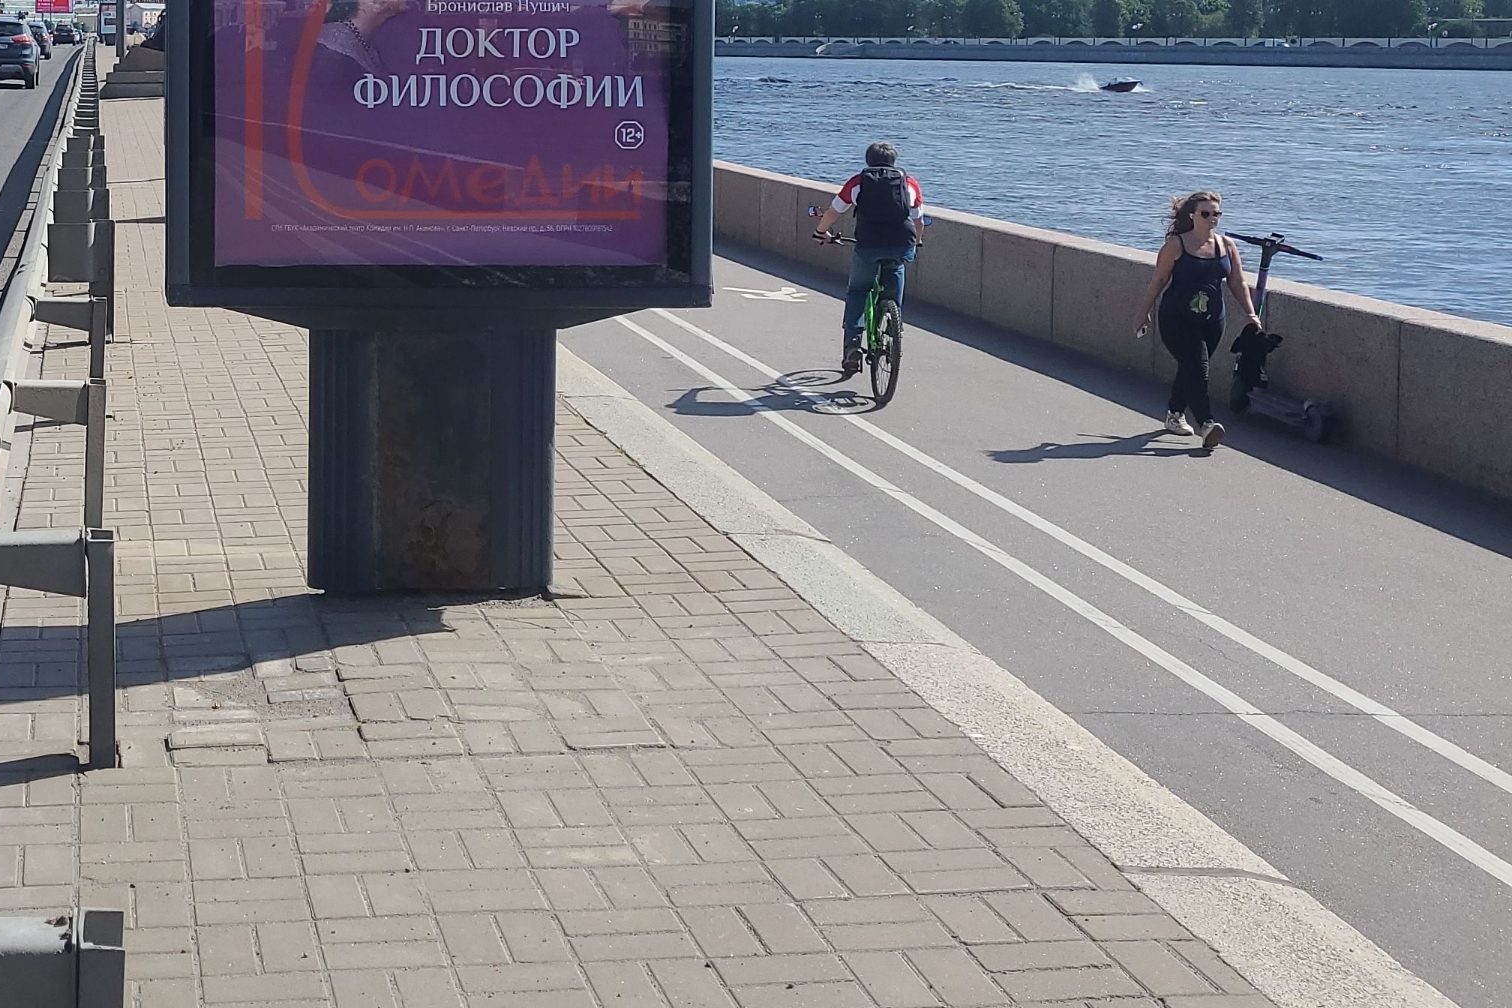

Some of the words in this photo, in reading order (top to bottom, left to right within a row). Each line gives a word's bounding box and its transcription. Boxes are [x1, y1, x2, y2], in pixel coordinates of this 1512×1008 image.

[416, 27, 580, 64] ДОКТОР
[353, 72, 644, 108] ФИЛОСОФИИ
[620, 128, 642, 142] 12+
